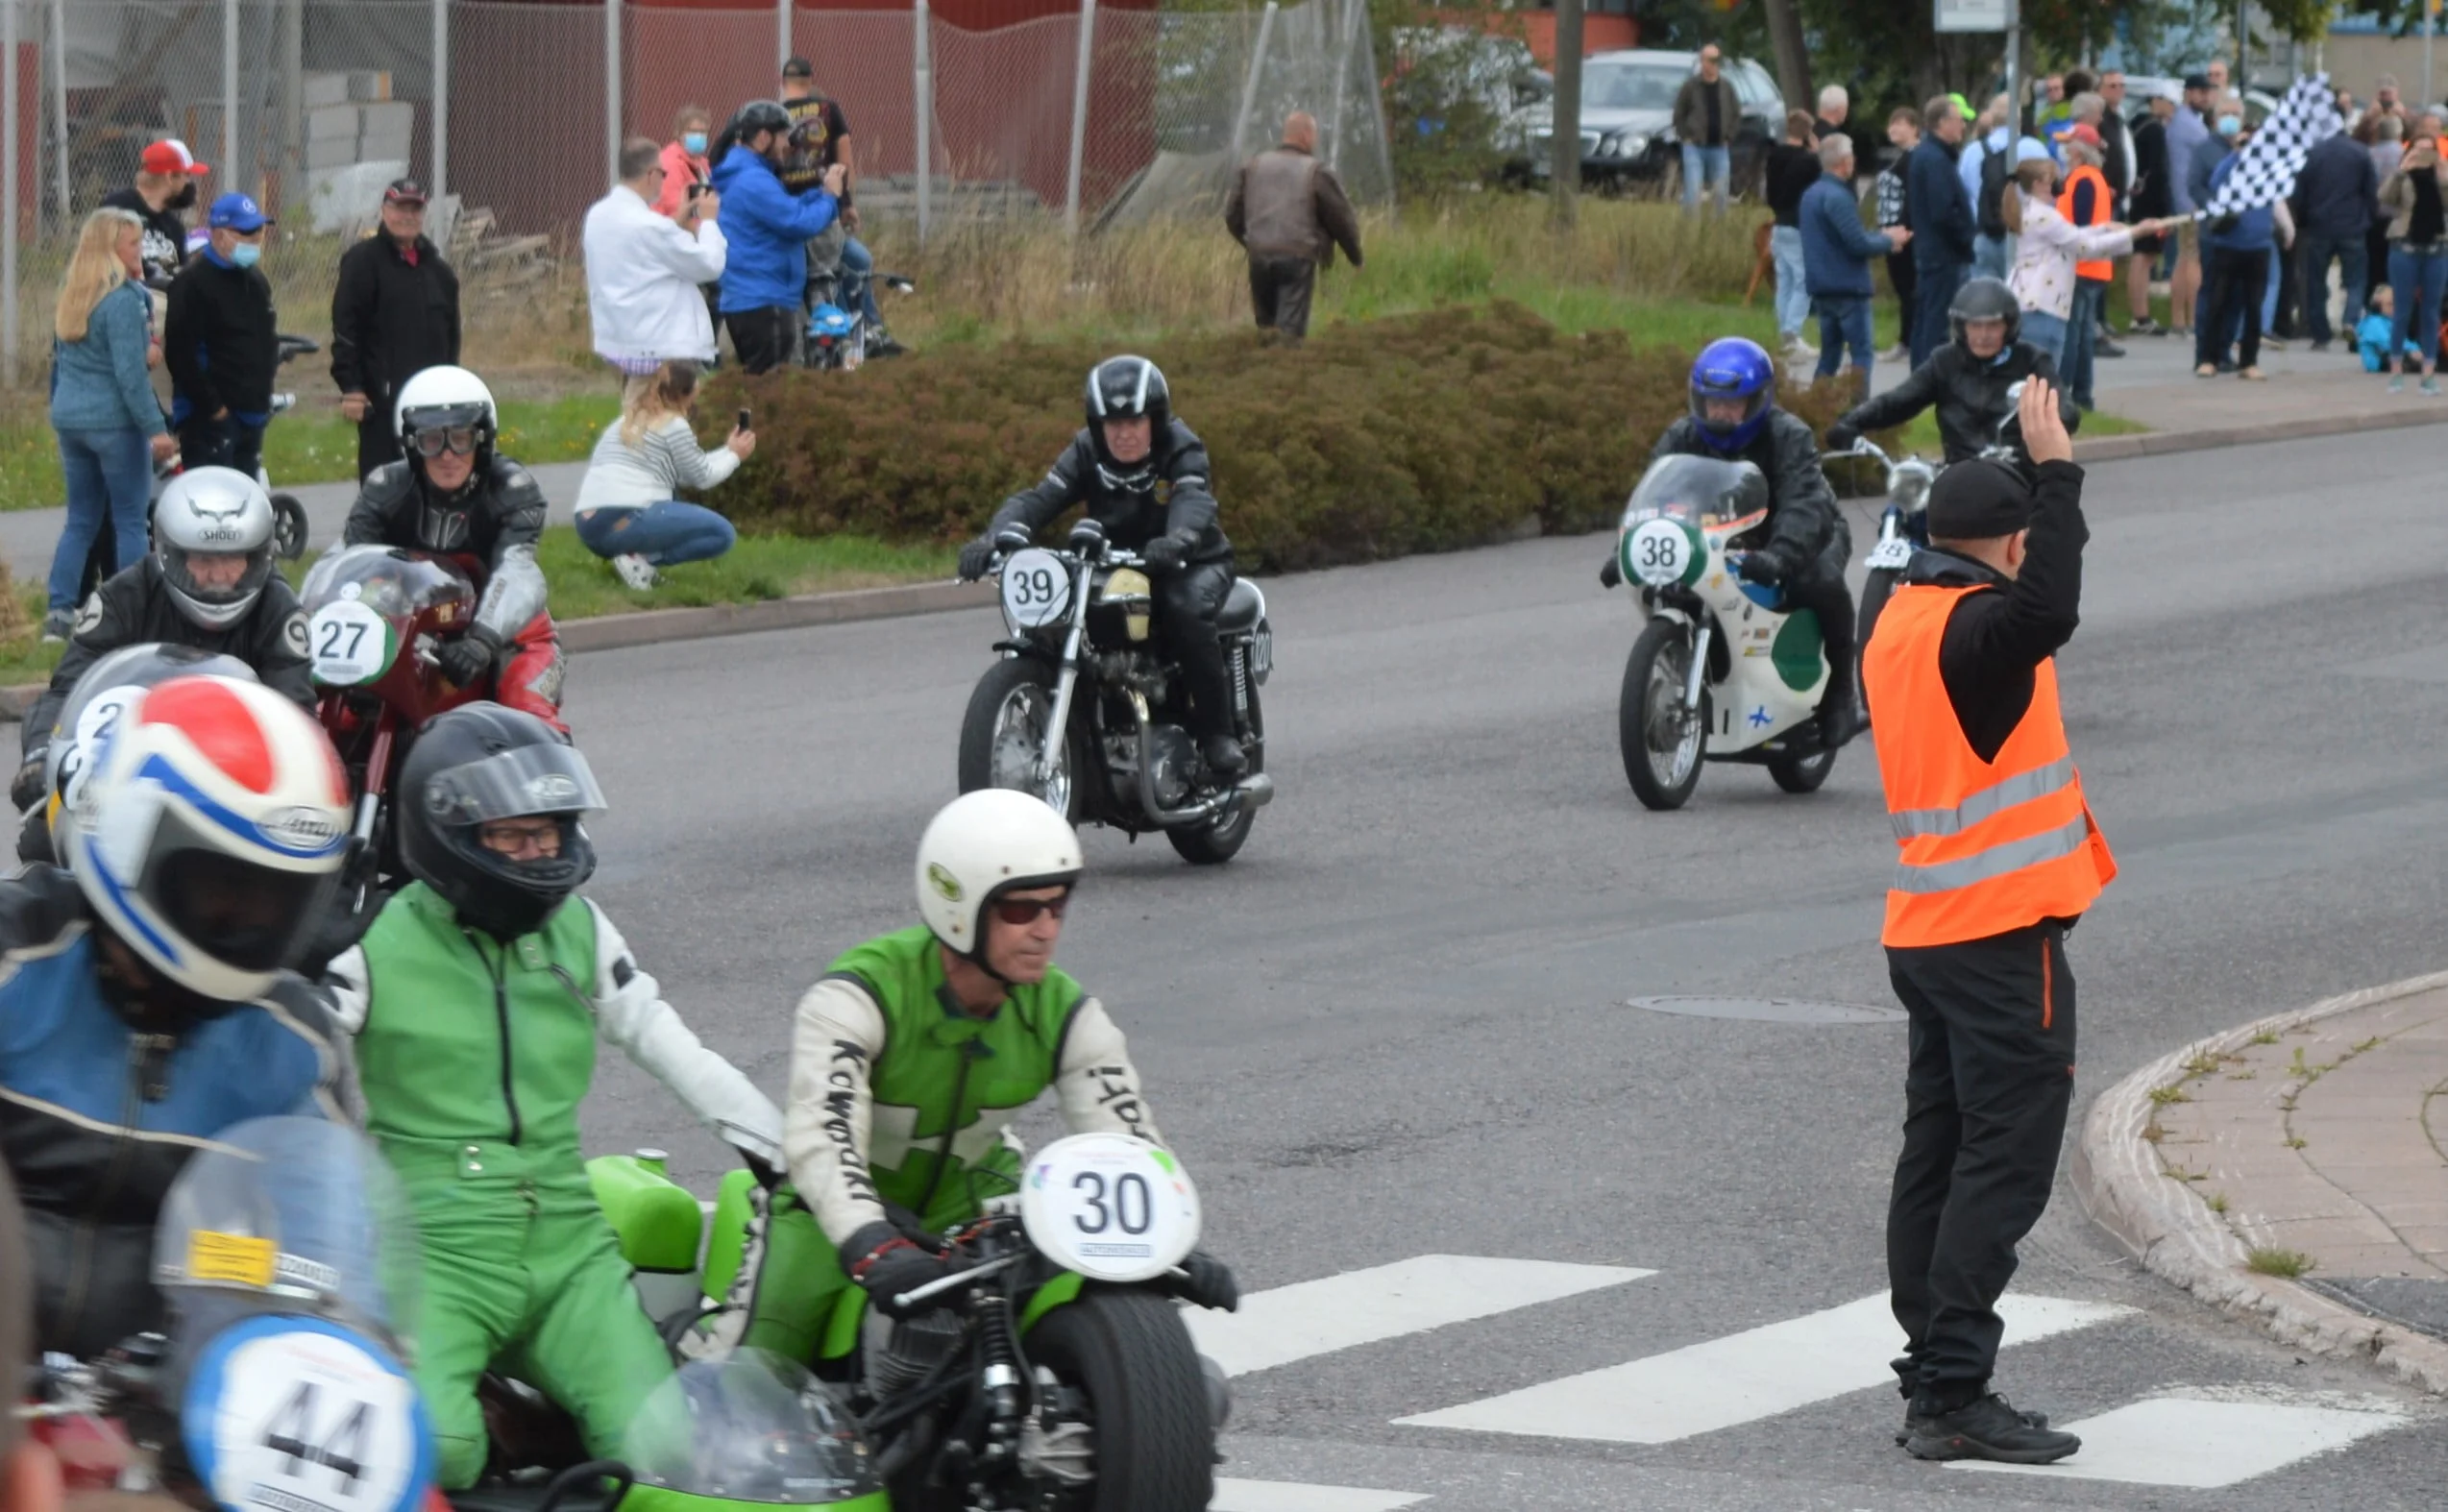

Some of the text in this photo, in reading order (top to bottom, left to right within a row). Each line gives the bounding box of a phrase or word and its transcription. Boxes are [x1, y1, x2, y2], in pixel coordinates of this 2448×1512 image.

[1641, 536, 1677, 567] 38
[1014, 569, 1054, 605] 39
[319, 621, 369, 660] 27
[92, 702, 125, 740] 2
[1072, 1170, 1151, 1235] 30
[259, 1379, 376, 1499] 44
